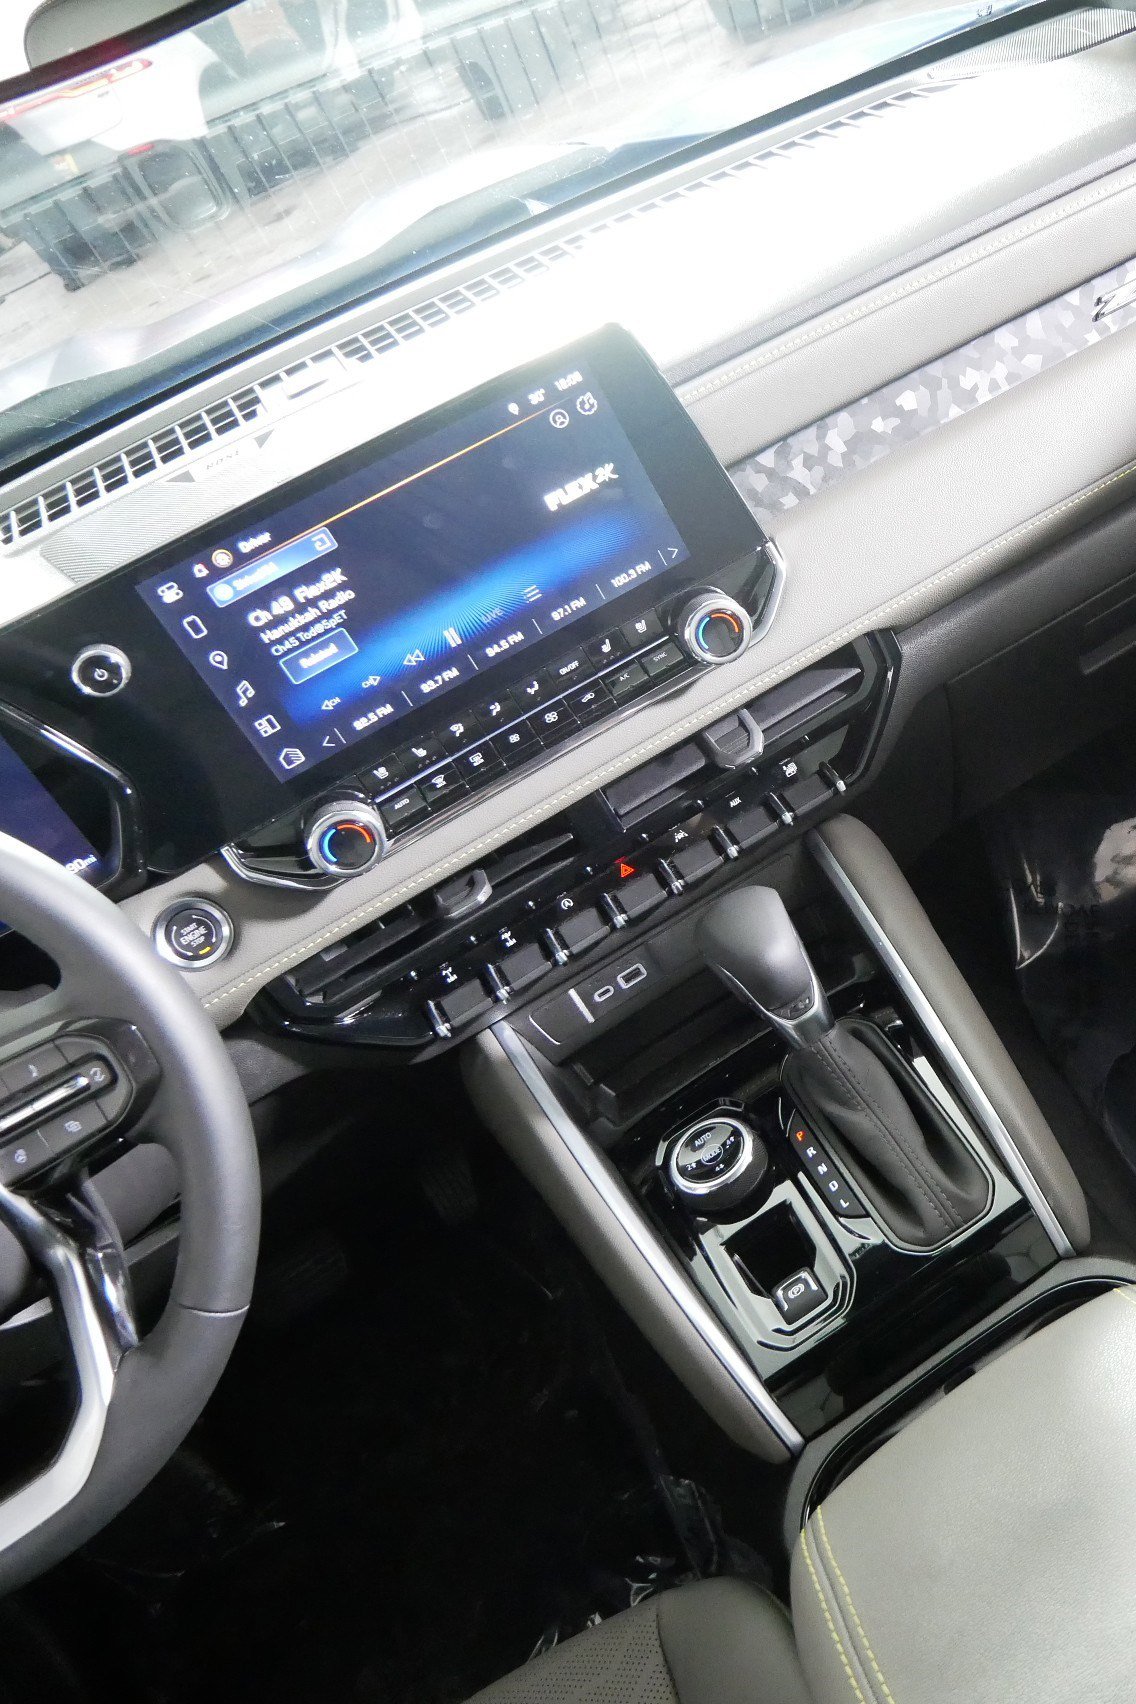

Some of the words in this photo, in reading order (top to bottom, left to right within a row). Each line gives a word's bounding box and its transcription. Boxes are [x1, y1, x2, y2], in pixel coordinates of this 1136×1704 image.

[635, 560, 652, 575] FM
[318, 590, 356, 613] Radio
[570, 596, 587, 612] FM
[247, 608, 274, 627] Ch
[506, 631, 525, 646] FM
[652, 651, 668, 663] SYNC
[441, 667, 460, 682] FM
[376, 703, 394, 718] FM
[394, 798, 410, 810] AUTO
[180, 922, 198, 936] START
[180, 925, 208, 945] ENGINE
[190, 935, 206, 948] STOP
[694, 1132, 712, 1147] AUTO
[806, 1146, 817, 1158] R
[817, 1162, 828, 1175] N
[828, 1180, 839, 1192] D
[840, 1198, 850, 1208] L
